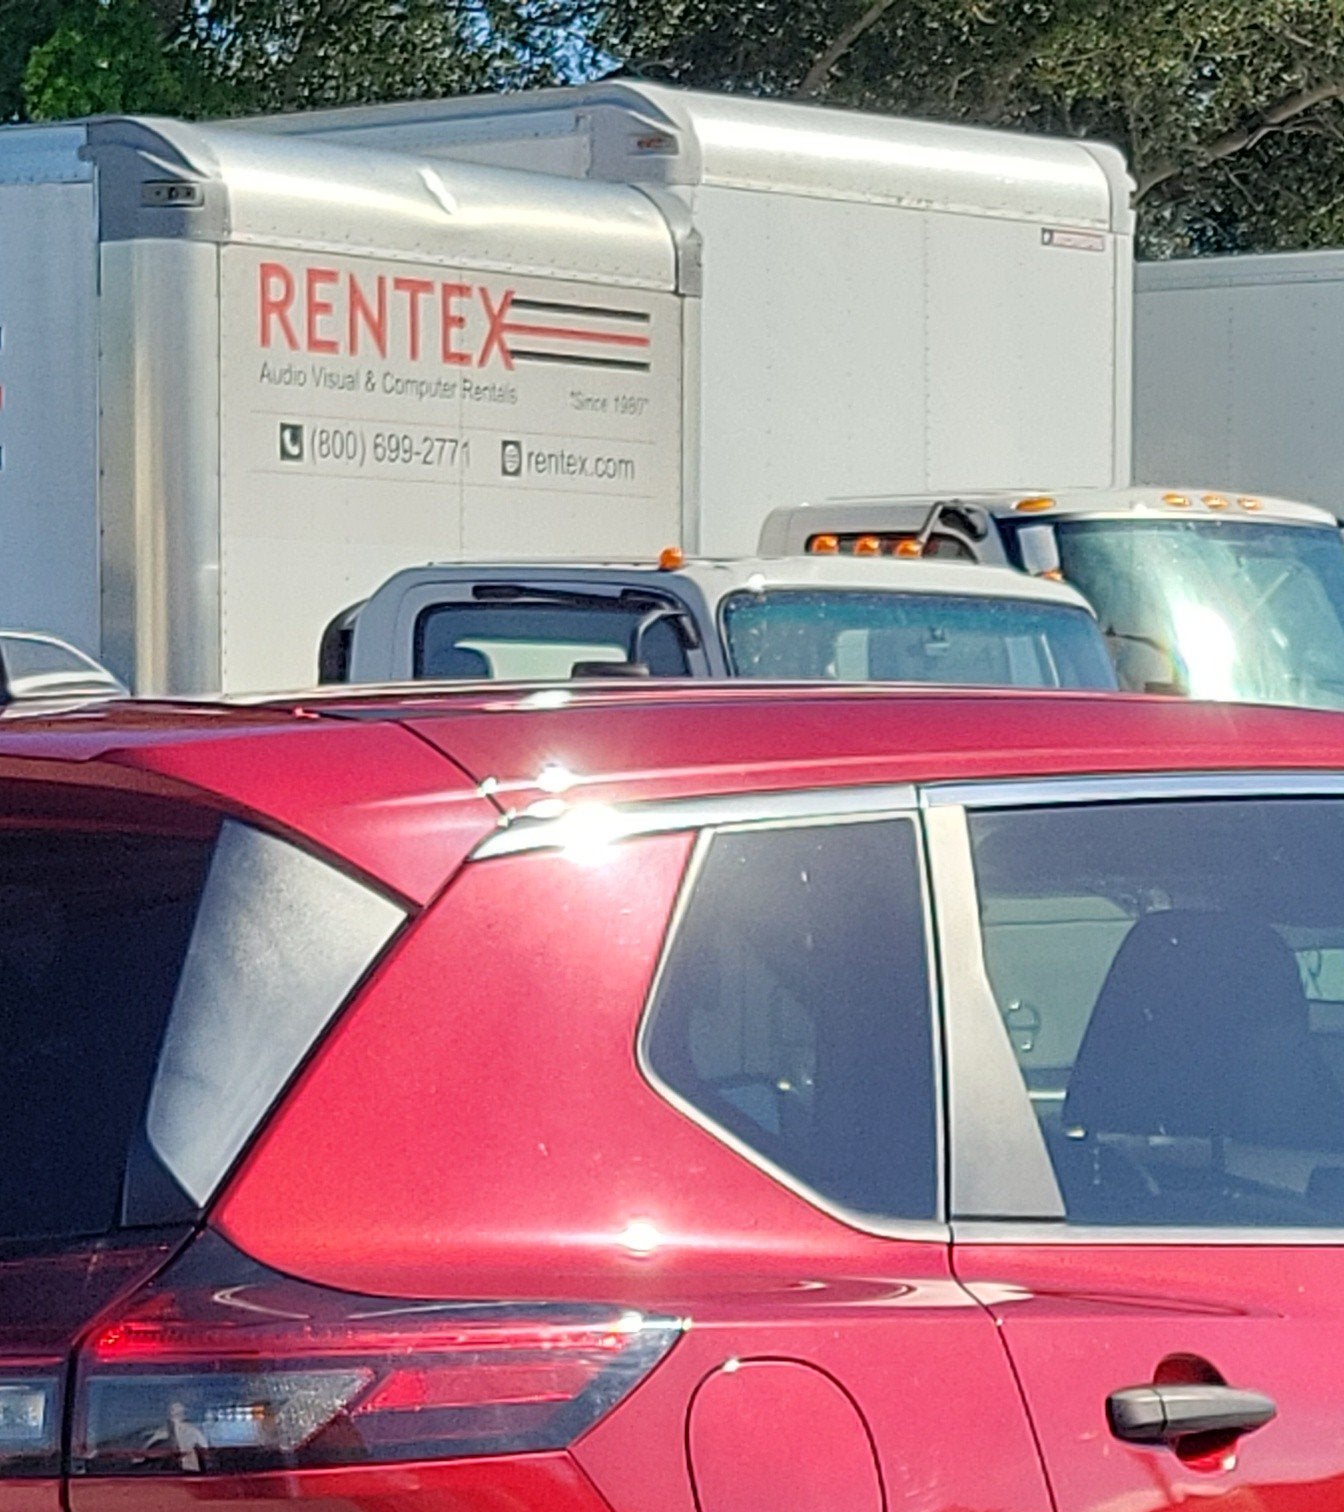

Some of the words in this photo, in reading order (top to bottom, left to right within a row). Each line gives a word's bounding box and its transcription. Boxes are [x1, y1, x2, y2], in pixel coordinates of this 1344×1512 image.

[260, 263, 517, 371] RENTEX
[260, 362, 306, 386] Audio
[312, 365, 358, 391] Visual
[365, 370, 376, 392] &
[382, 372, 458, 401] Computer
[461, 378, 518, 404] Rentals
[311, 429, 365, 467] (800)
[373, 433, 471, 469] 699-2771
[527, 450, 636, 481] rentex.com
